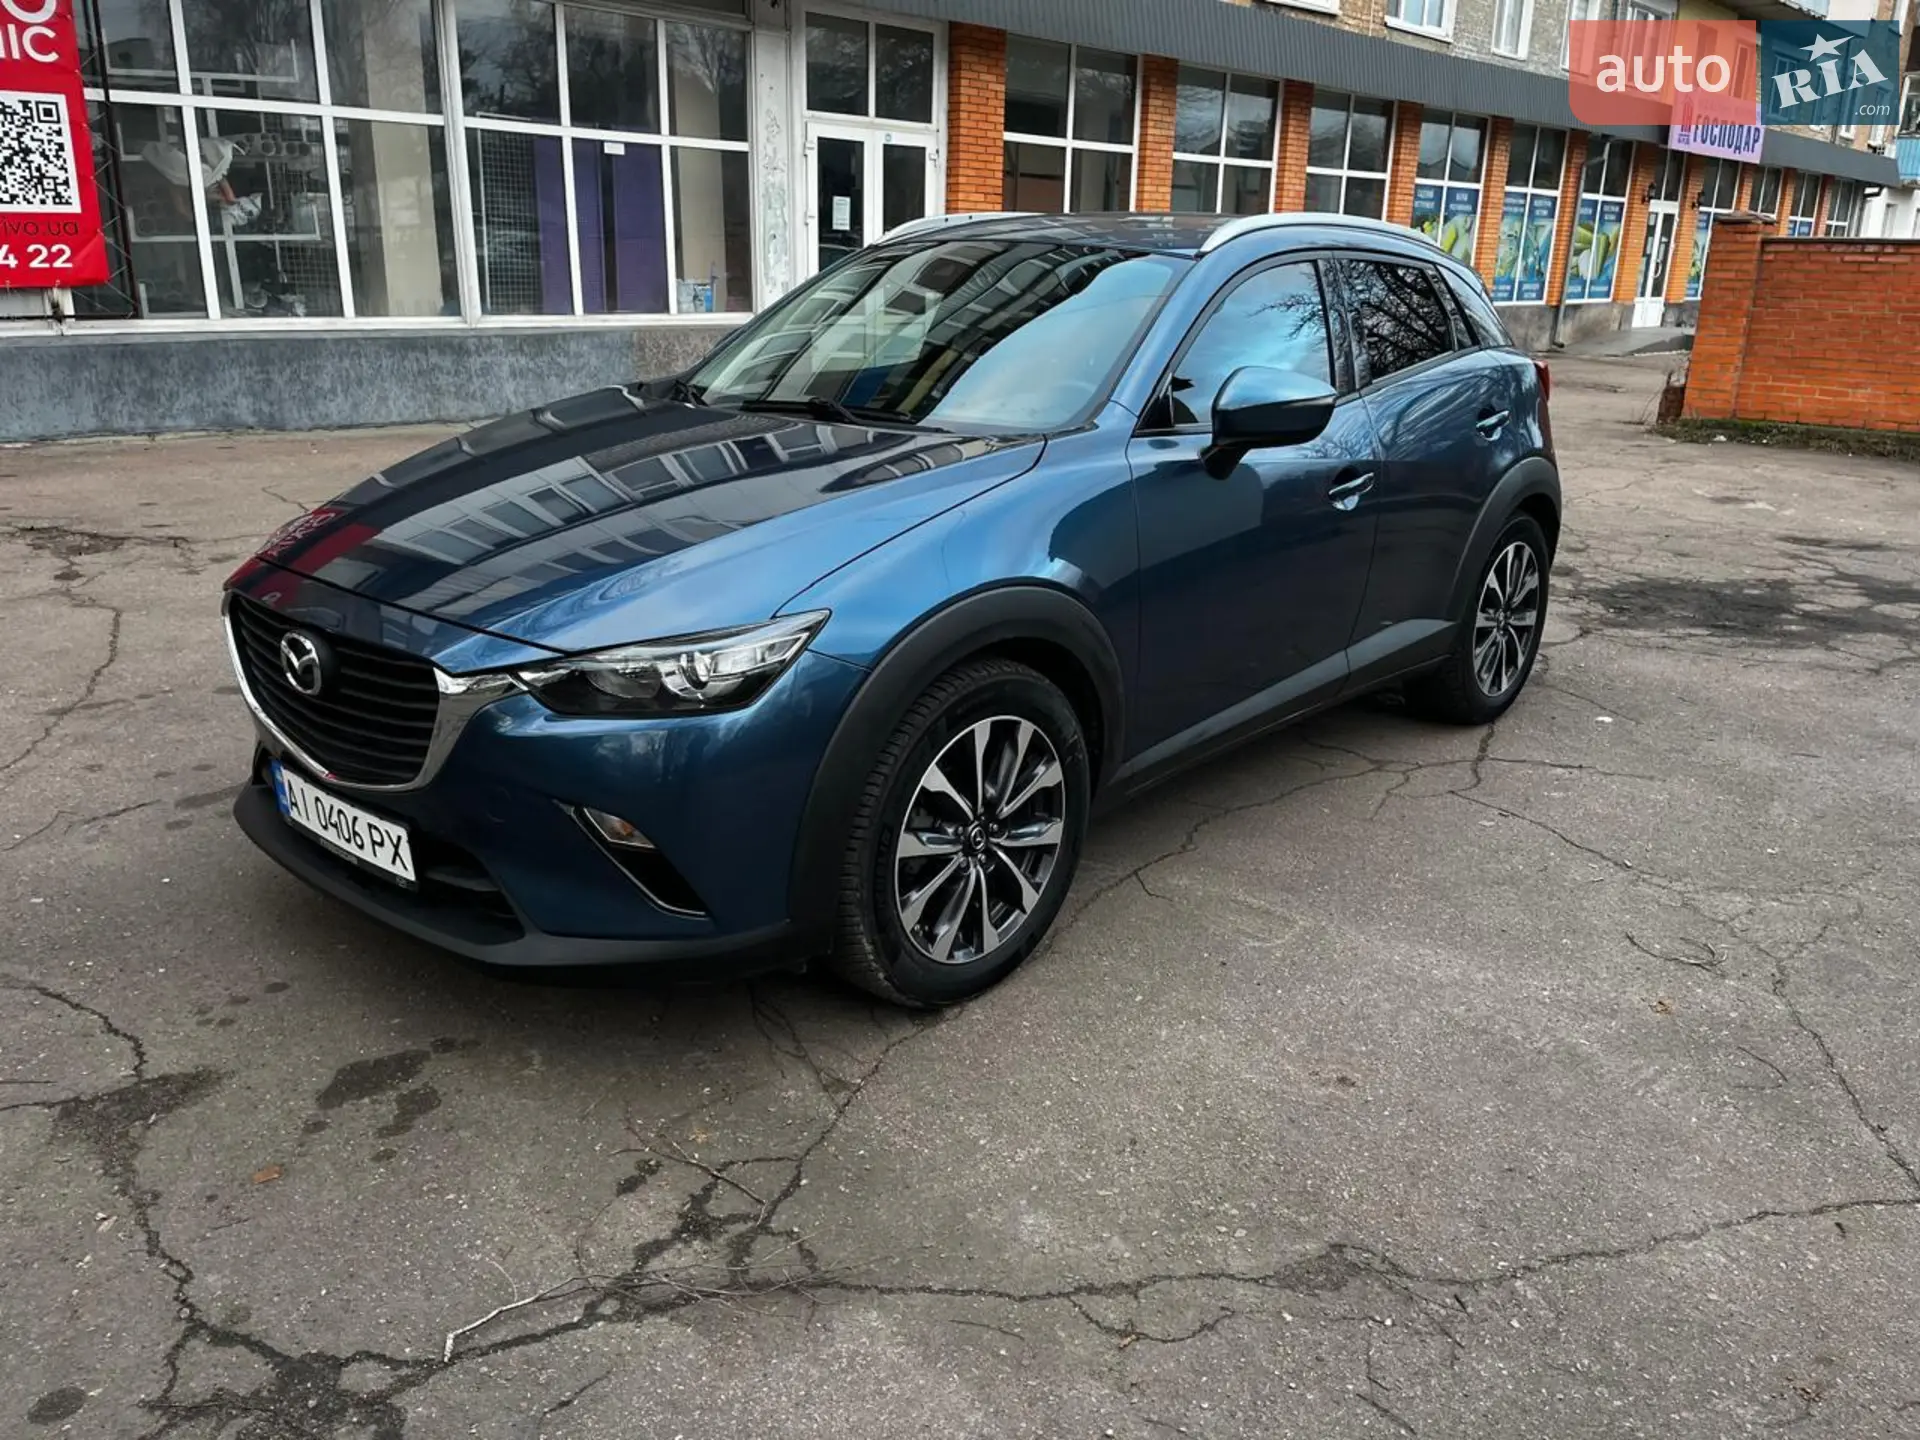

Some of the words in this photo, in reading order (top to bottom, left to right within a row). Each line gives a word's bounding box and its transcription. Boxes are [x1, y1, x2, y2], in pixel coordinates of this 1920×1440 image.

[1693, 113, 1761, 154] ГОСПОДАР
[27, 244, 73, 268] 22
[287, 778, 310, 822] AI
[314, 795, 365, 851] 0406
[367, 821, 409, 872] PX
